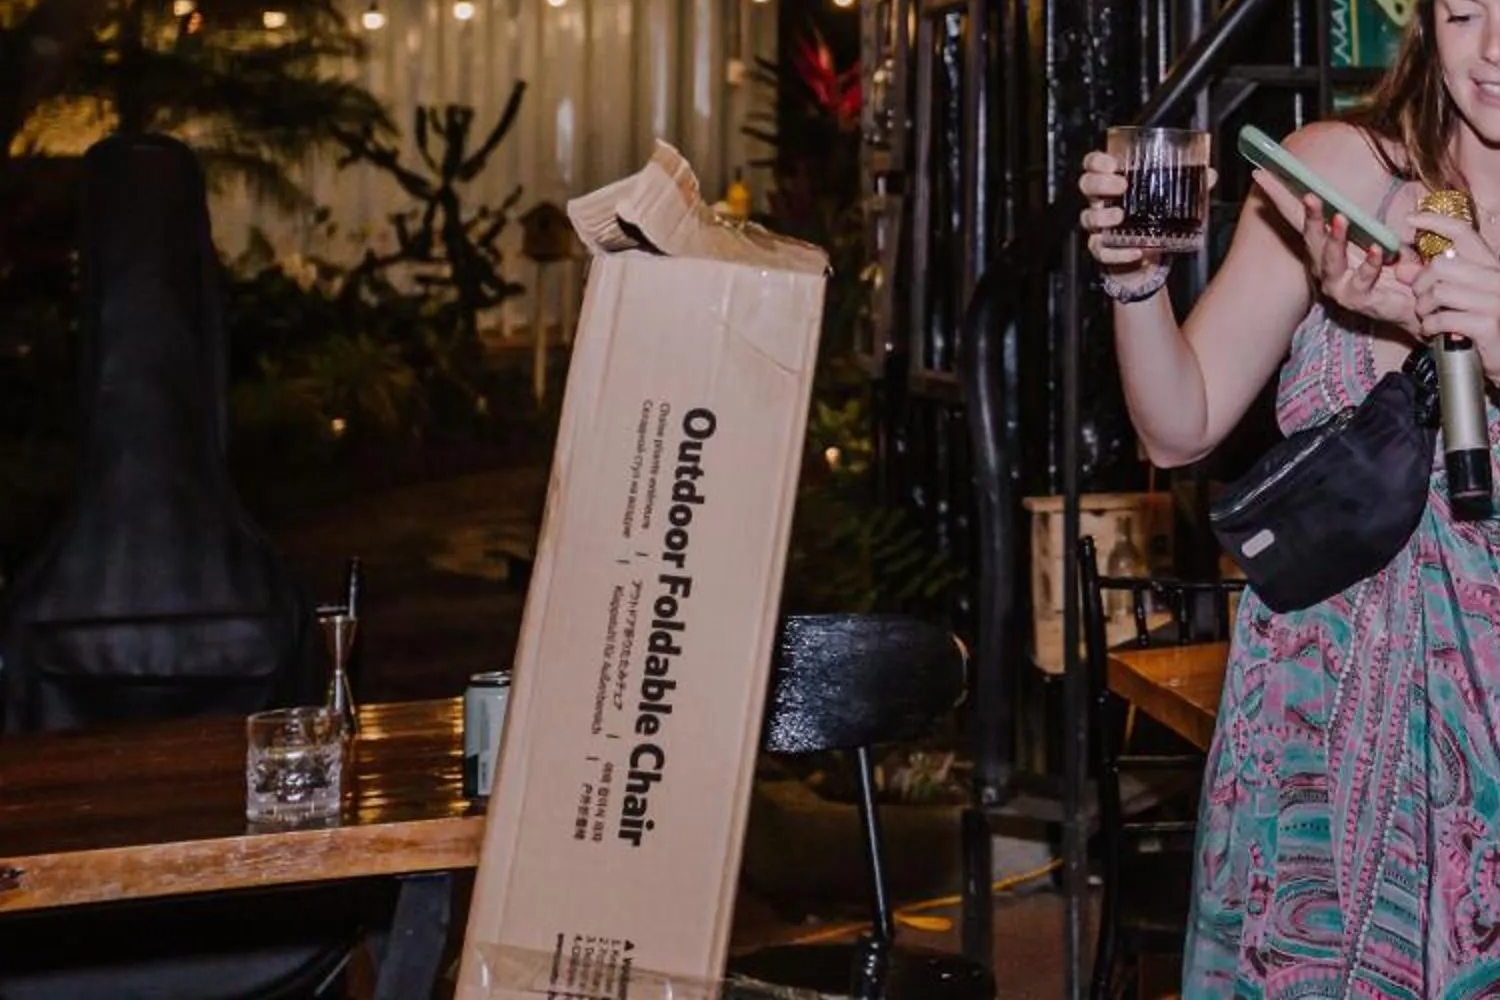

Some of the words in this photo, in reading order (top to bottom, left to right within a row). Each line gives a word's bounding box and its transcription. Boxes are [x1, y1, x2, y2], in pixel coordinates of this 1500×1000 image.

[662, 408, 716, 569] Outdoor
[635, 574, 692, 736] Foldable
[618, 743, 665, 847] Chair
